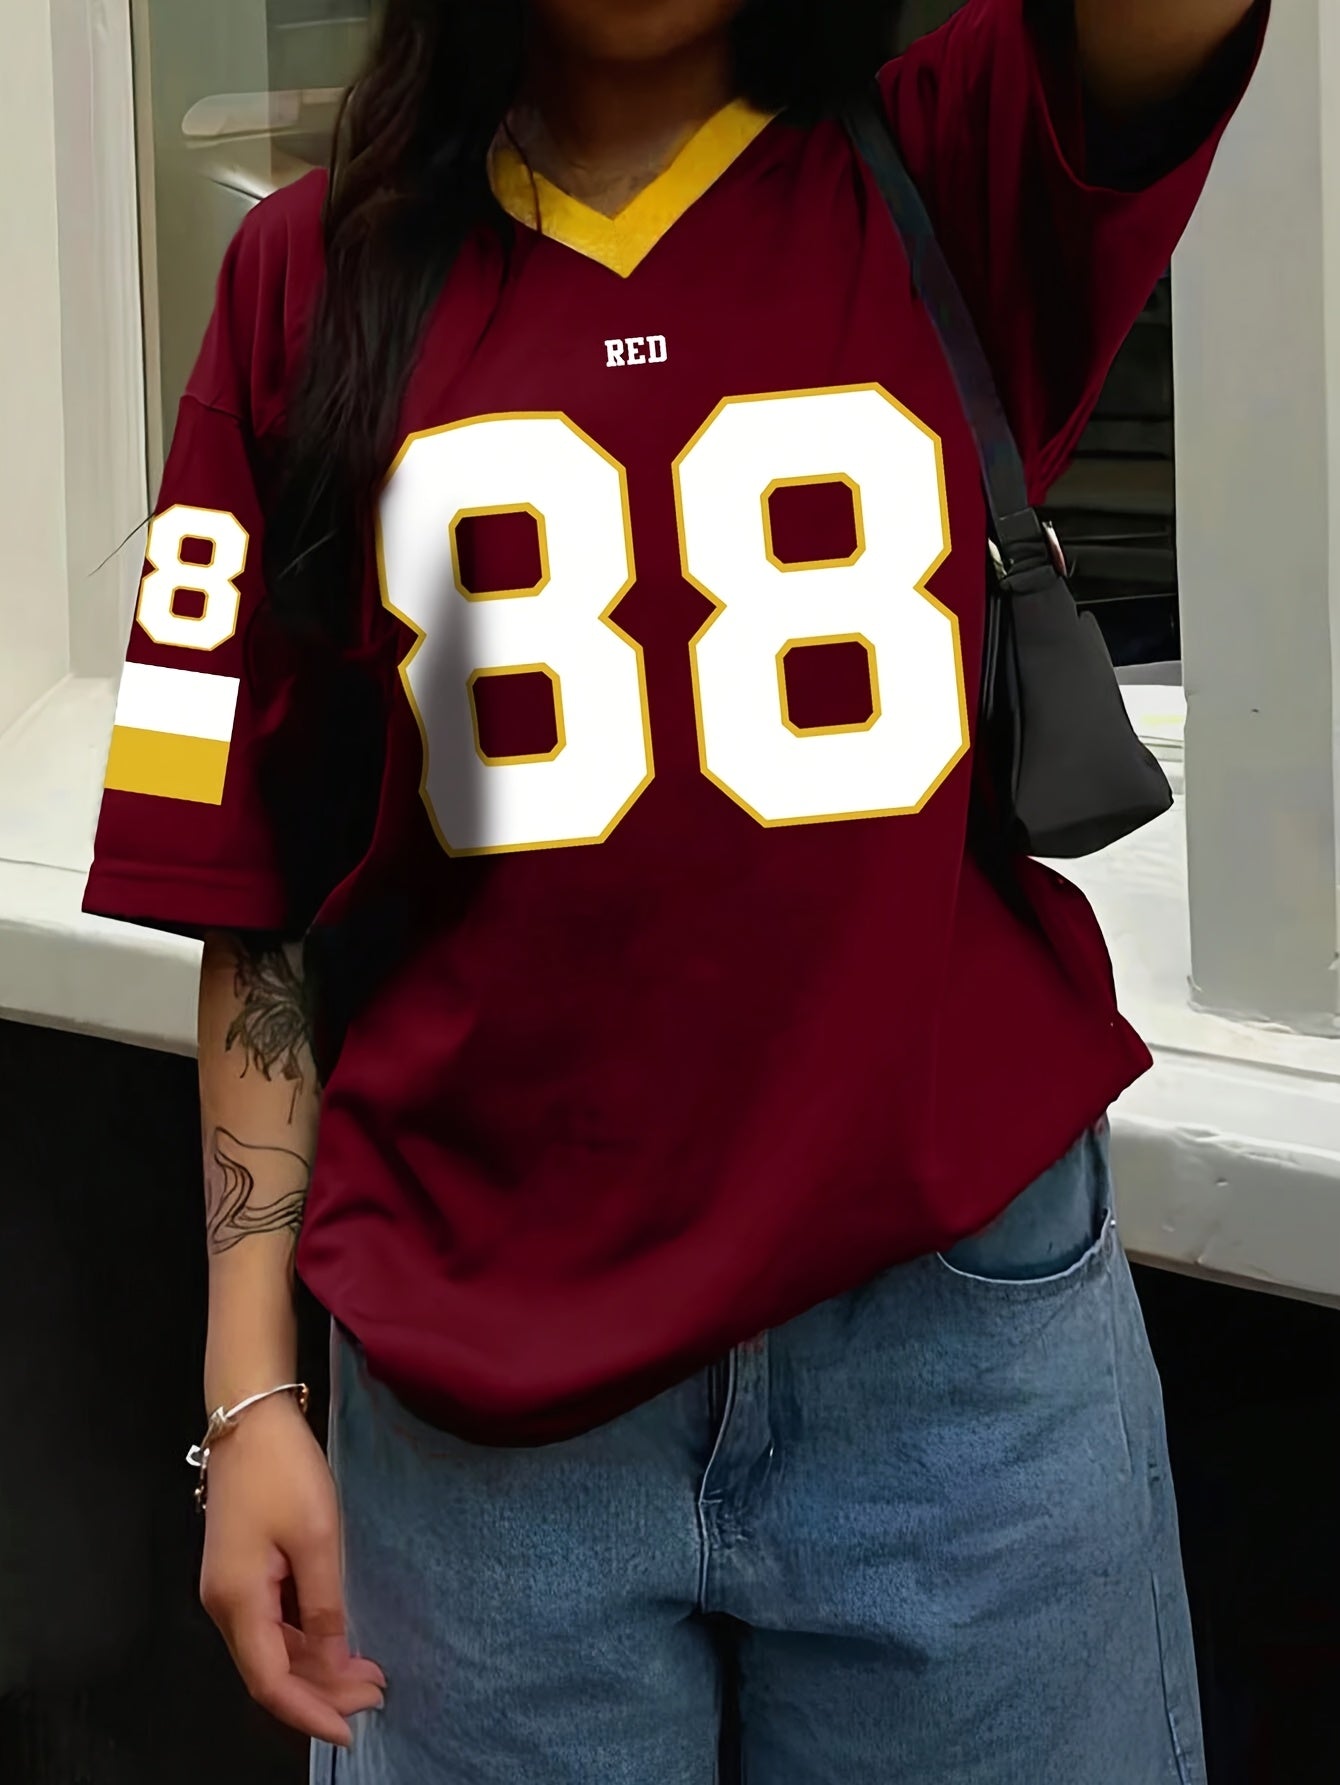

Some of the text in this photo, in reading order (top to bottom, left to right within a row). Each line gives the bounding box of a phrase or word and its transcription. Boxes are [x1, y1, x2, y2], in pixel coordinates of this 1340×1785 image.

[604, 334, 668, 368] RED
[136, 503, 250, 652] 8
[376, 382, 971, 859] 88
